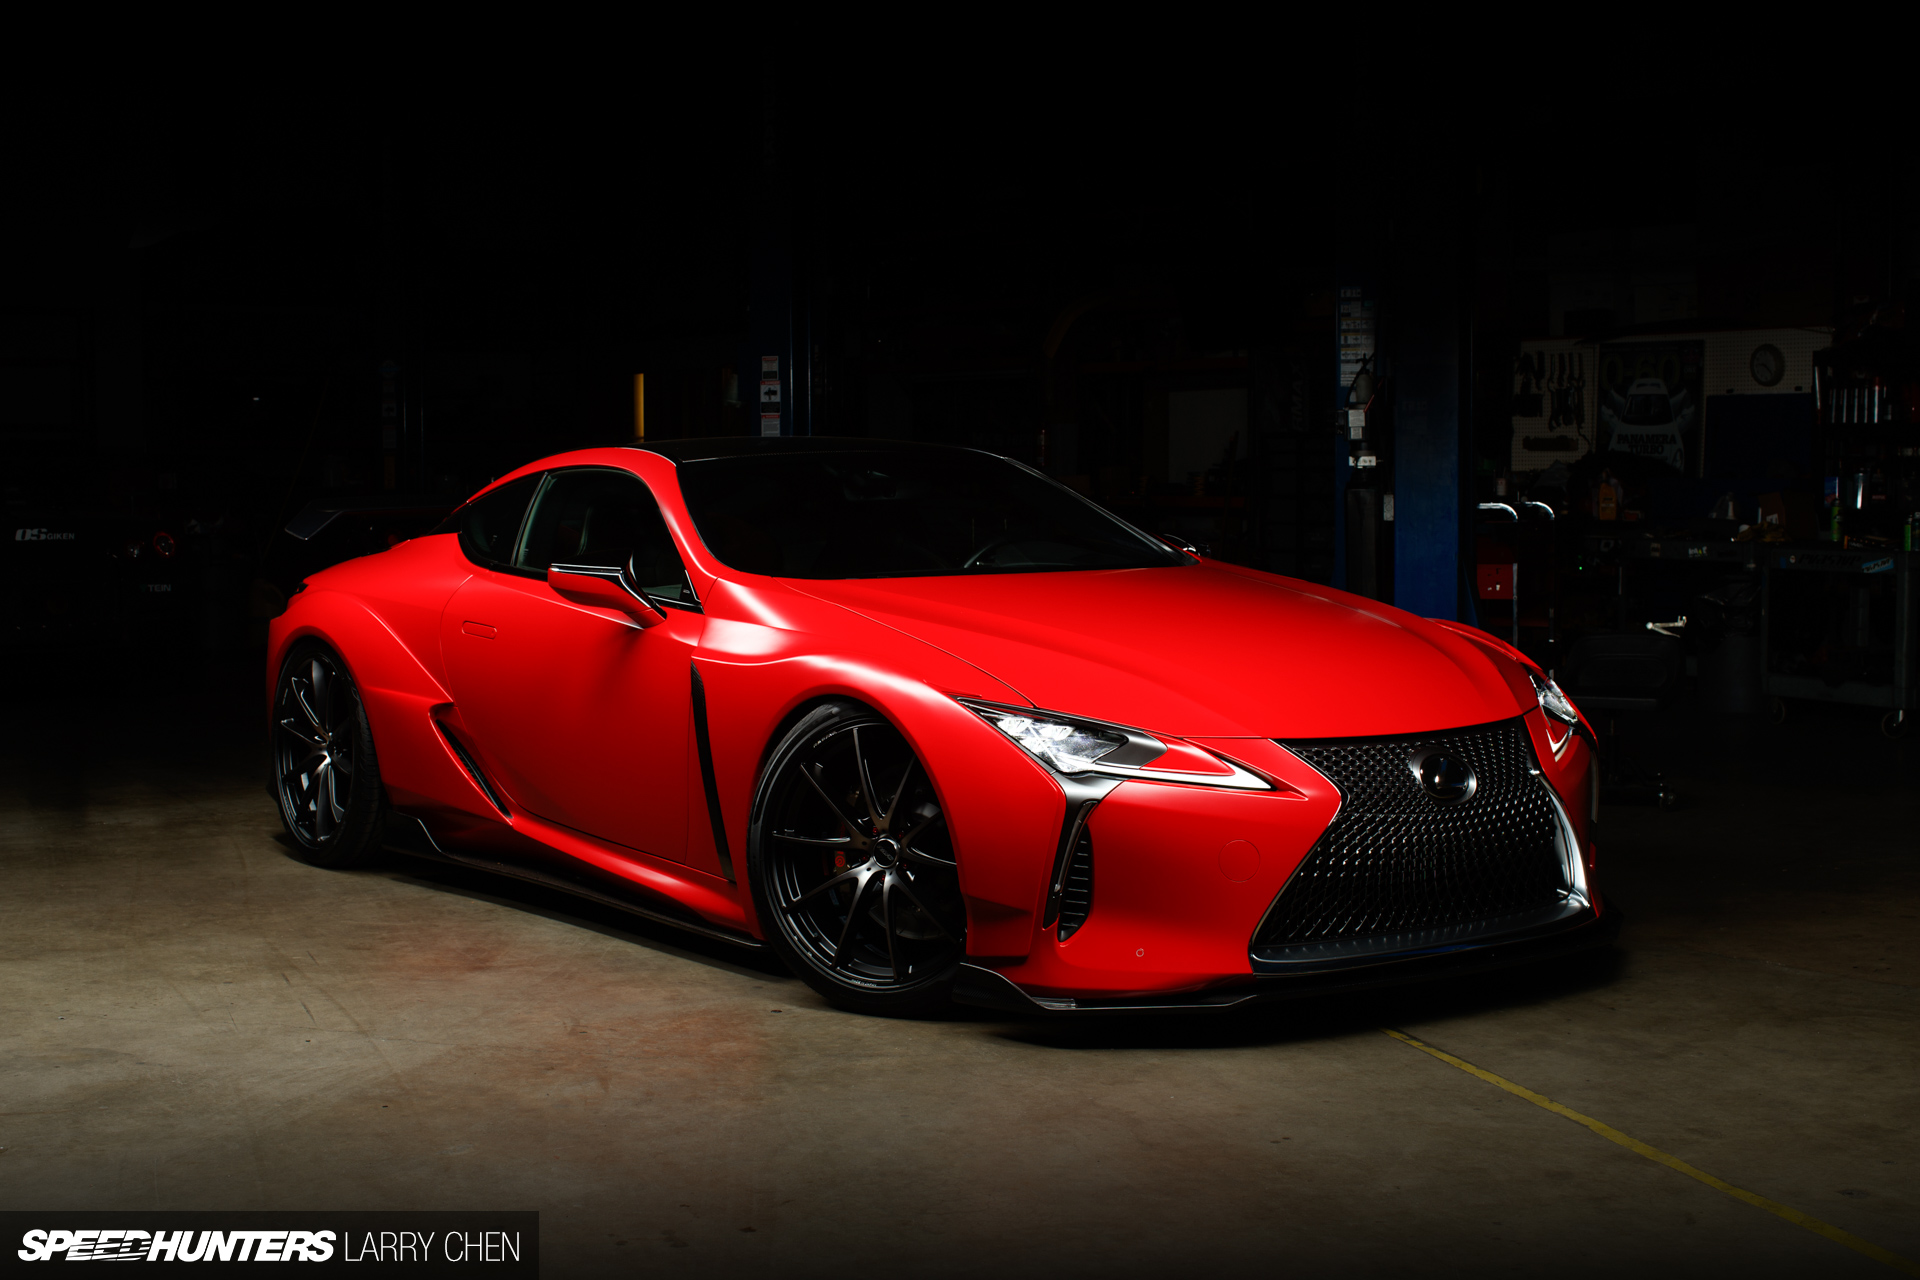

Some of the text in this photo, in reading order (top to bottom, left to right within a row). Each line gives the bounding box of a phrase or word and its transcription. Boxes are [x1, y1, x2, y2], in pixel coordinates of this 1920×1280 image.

[1617, 434, 1677, 444] PANAMERA
[1629, 445, 1664, 455] TURBO
[15, 528, 47, 541] OS
[147, 584, 172, 592] TEIN
